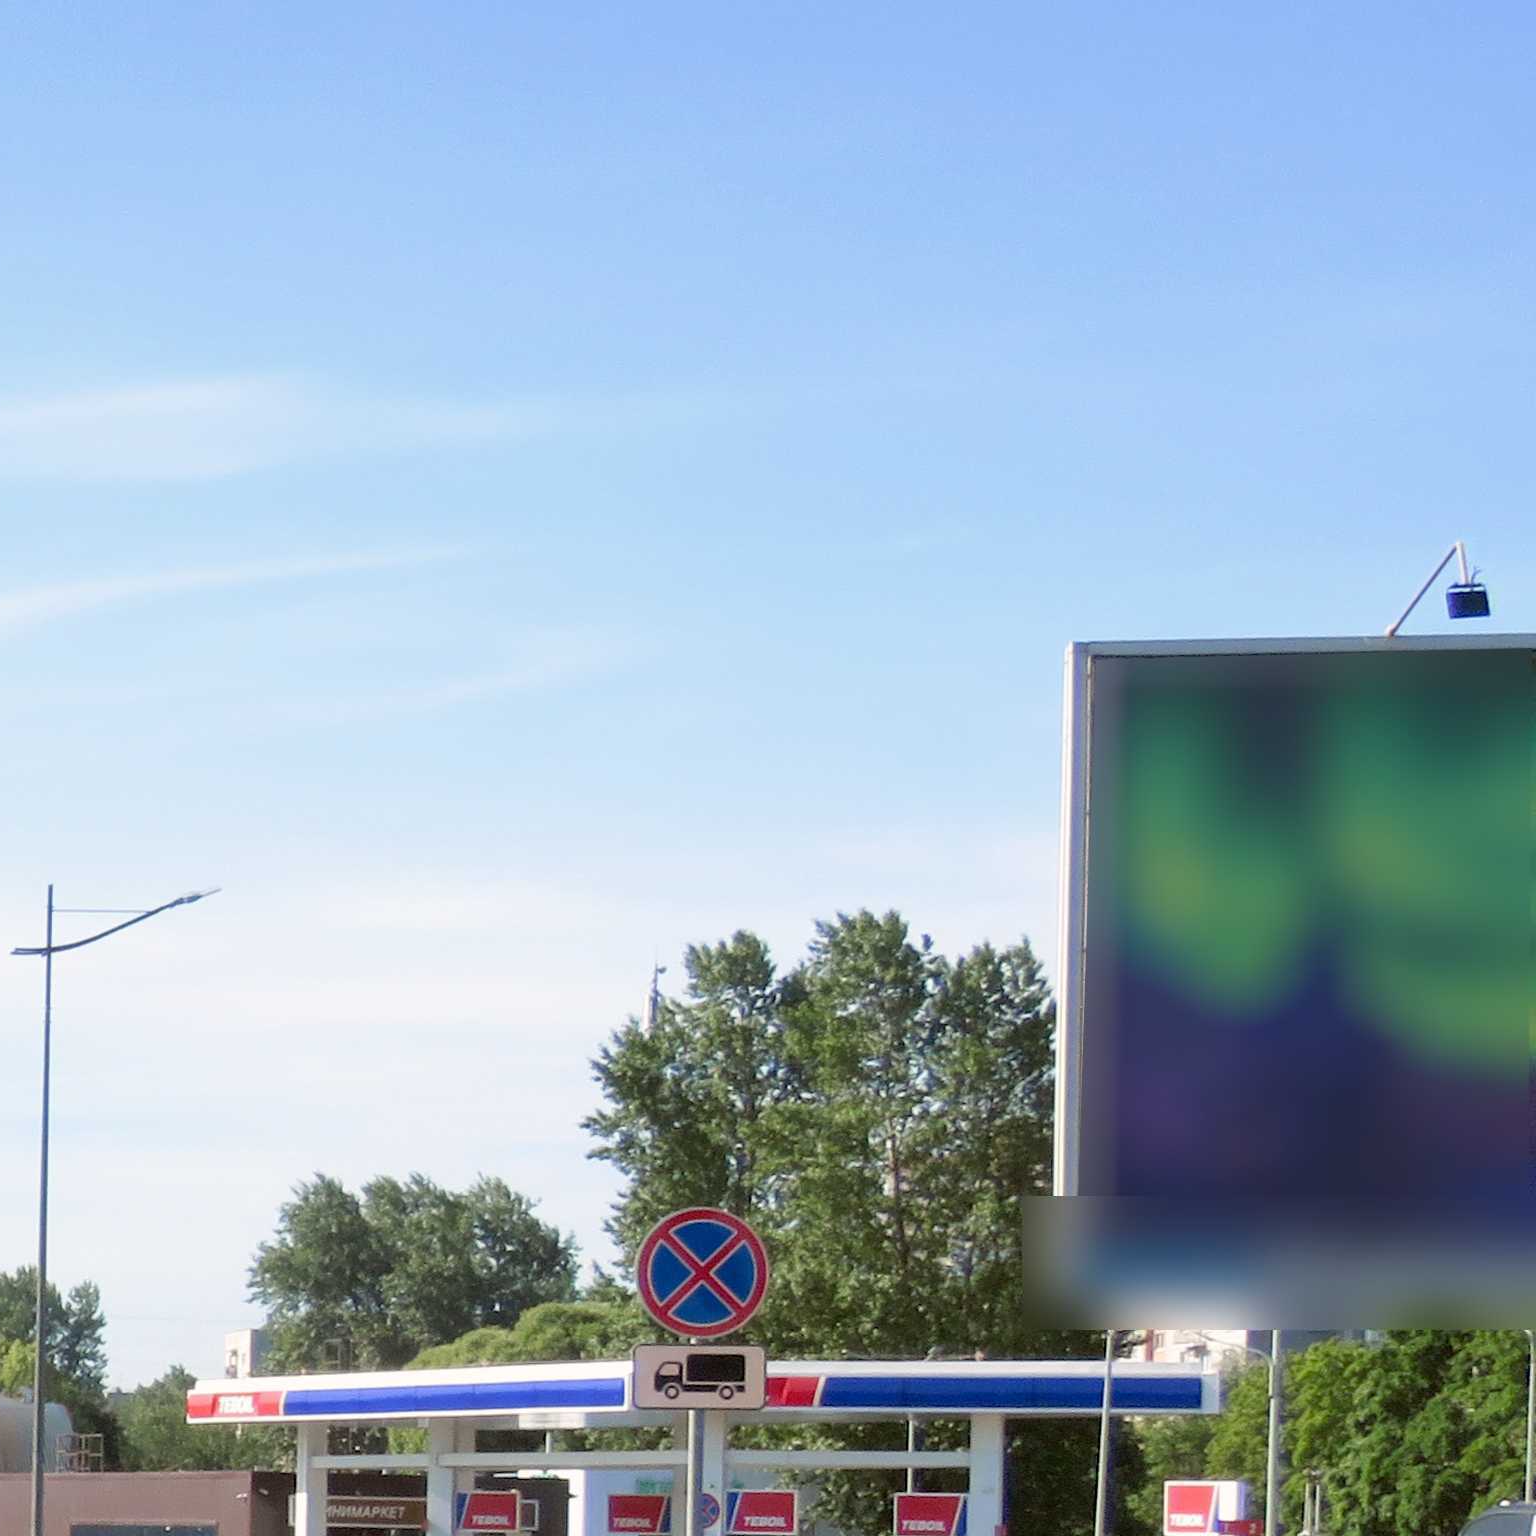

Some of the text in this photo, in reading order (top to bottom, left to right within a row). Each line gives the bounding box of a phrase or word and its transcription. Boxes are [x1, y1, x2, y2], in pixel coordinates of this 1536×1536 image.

[471, 1515, 510, 1526] TEBOIL
[612, 1517, 652, 1529] TEBOIL
[743, 1515, 787, 1528] TEBOIL
[901, 1519, 946, 1532] TEBOIL
